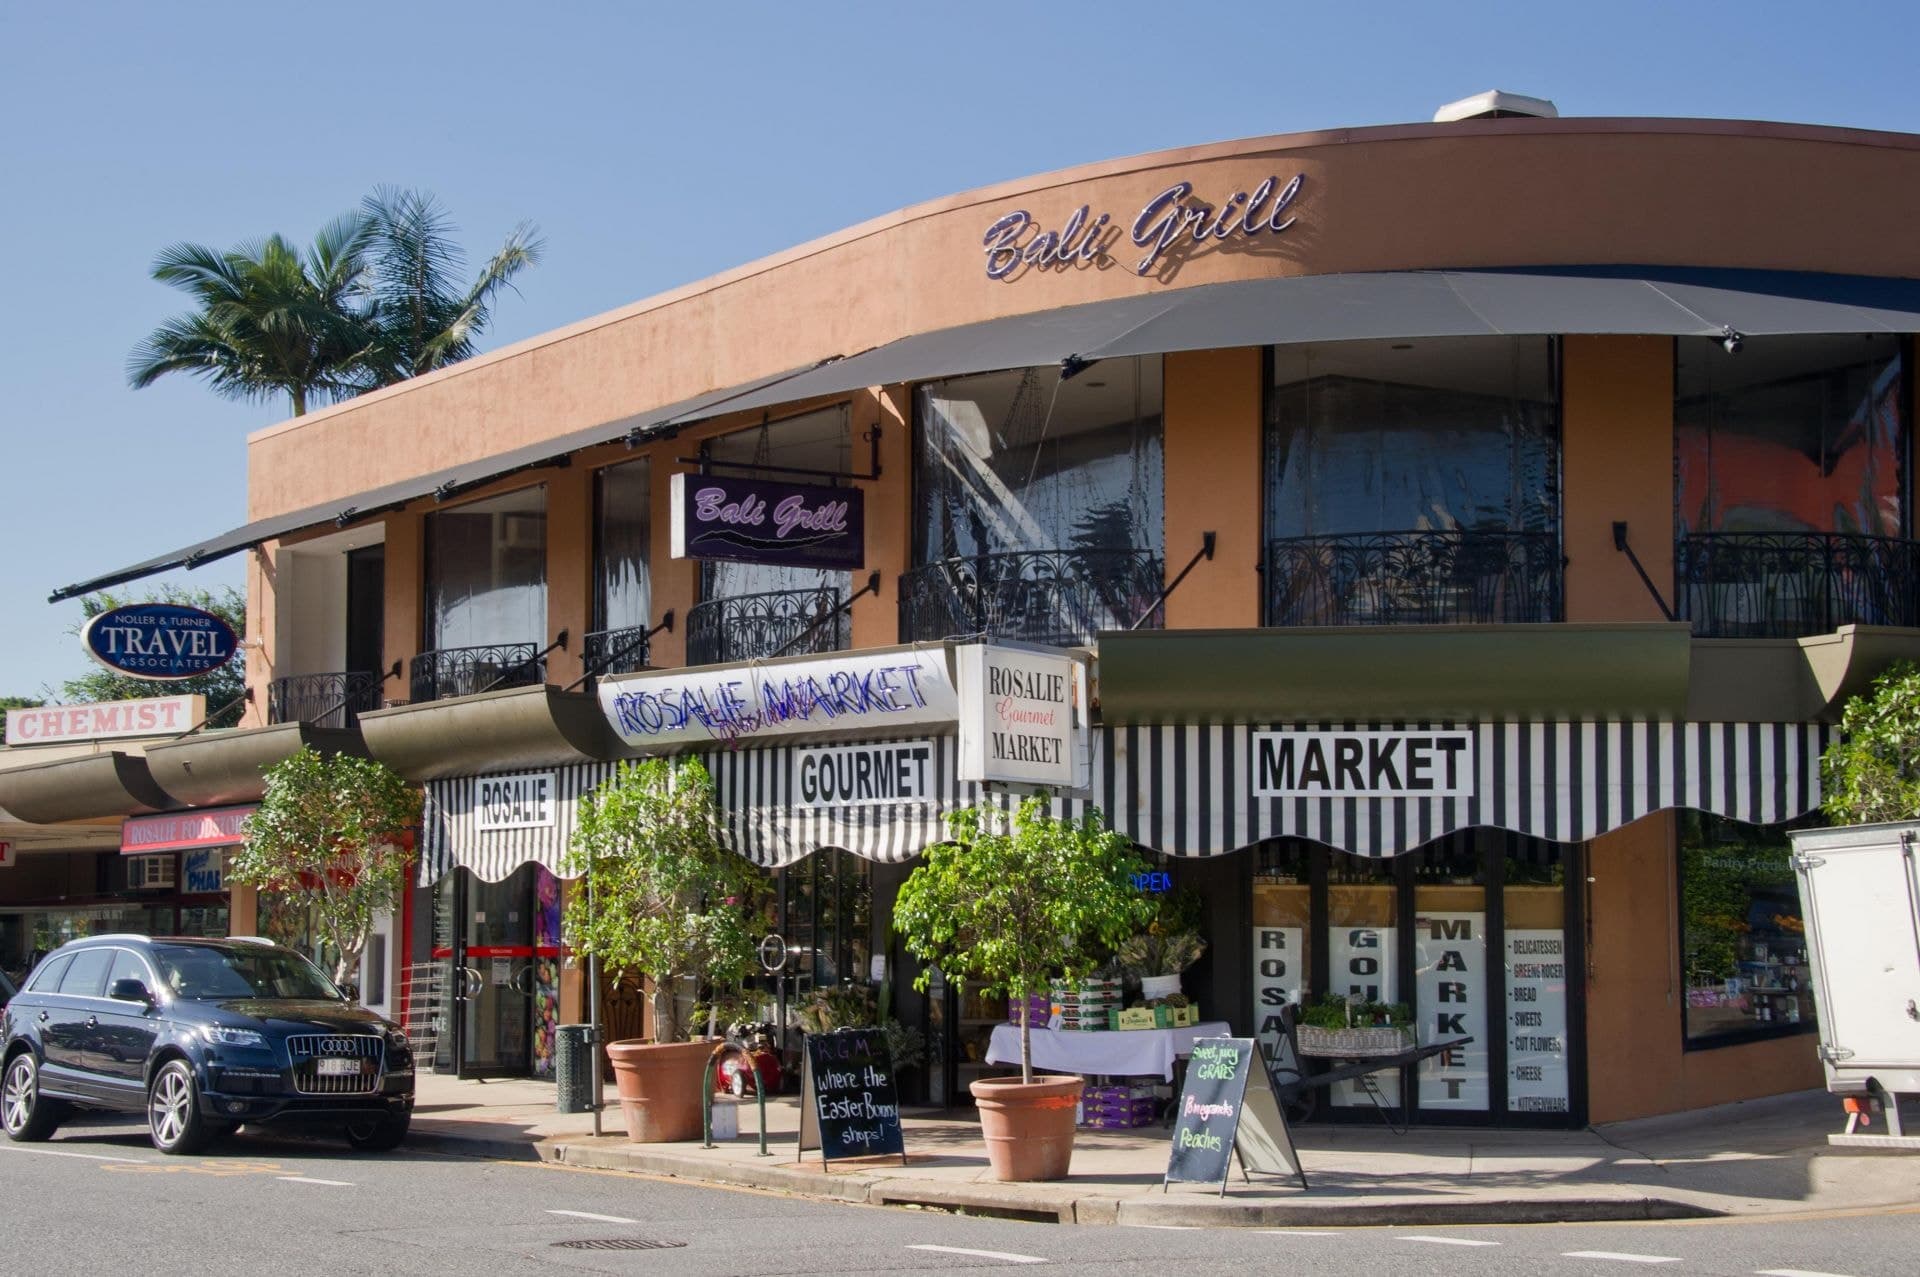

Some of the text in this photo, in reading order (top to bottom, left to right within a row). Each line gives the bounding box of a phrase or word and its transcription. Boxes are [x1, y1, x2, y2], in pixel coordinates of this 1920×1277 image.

[984, 173, 1305, 280] Bali Grill
[695, 487, 849, 539] Bali Grill
[115, 615, 212, 628] NOLLER & TURNER
[101, 626, 226, 658] TRAVEL
[119, 657, 210, 669] ASSOCIATES
[761, 663, 928, 724] MARKET
[989, 665, 1064, 703] ROSALIE
[17, 702, 181, 739] CHEMIST
[995, 696, 1056, 730] Gourmet
[992, 731, 1063, 765] MARKET
[801, 747, 929, 803] GOURMET
[1259, 737, 1467, 790] MARKET
[482, 778, 547, 826] ROSALIE
[131, 822, 176, 844] ROSALIE
[1514, 940, 1562, 955] DELICATESSEN
[1260, 930, 1287, 1062] ROSAL
[1514, 987, 1537, 1002] BREAD
[432, 1016, 448, 1032] ICE
[1431, 920, 1471, 1099] MARKET
[1515, 1011, 1543, 1026] SWEETS
[1515, 1036, 1562, 1051] CUT FLOWERS
[818, 1065, 888, 1092] where the
[1516, 1065, 1543, 1081] CHEESE
[818, 1095, 864, 1120] Easter
[842, 1123, 885, 1148] shops!
[1179, 1128, 1222, 1152] Peaches
